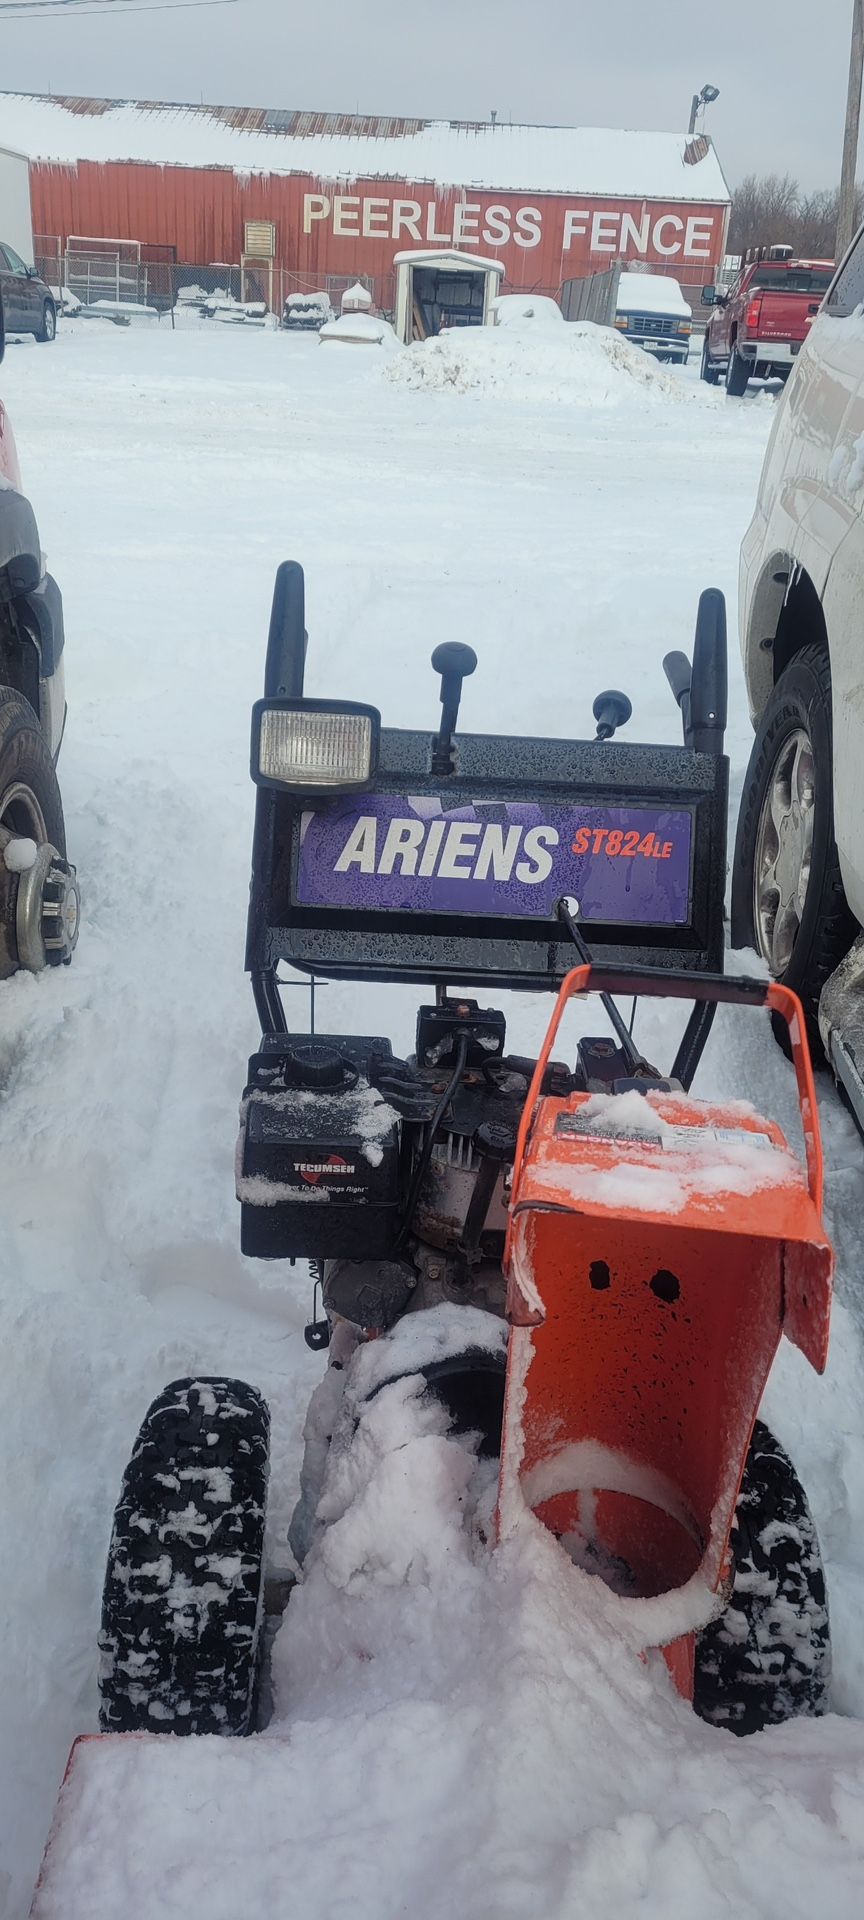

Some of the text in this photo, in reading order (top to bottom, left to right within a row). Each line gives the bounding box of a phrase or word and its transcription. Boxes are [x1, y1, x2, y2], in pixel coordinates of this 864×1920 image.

[303, 194, 712, 257] PEERLESS FENCE
[333, 816, 559, 884] ARIENS
[293, 1163, 355, 1173] TECUMSEH
[322, 1185, 345, 1193] Things
